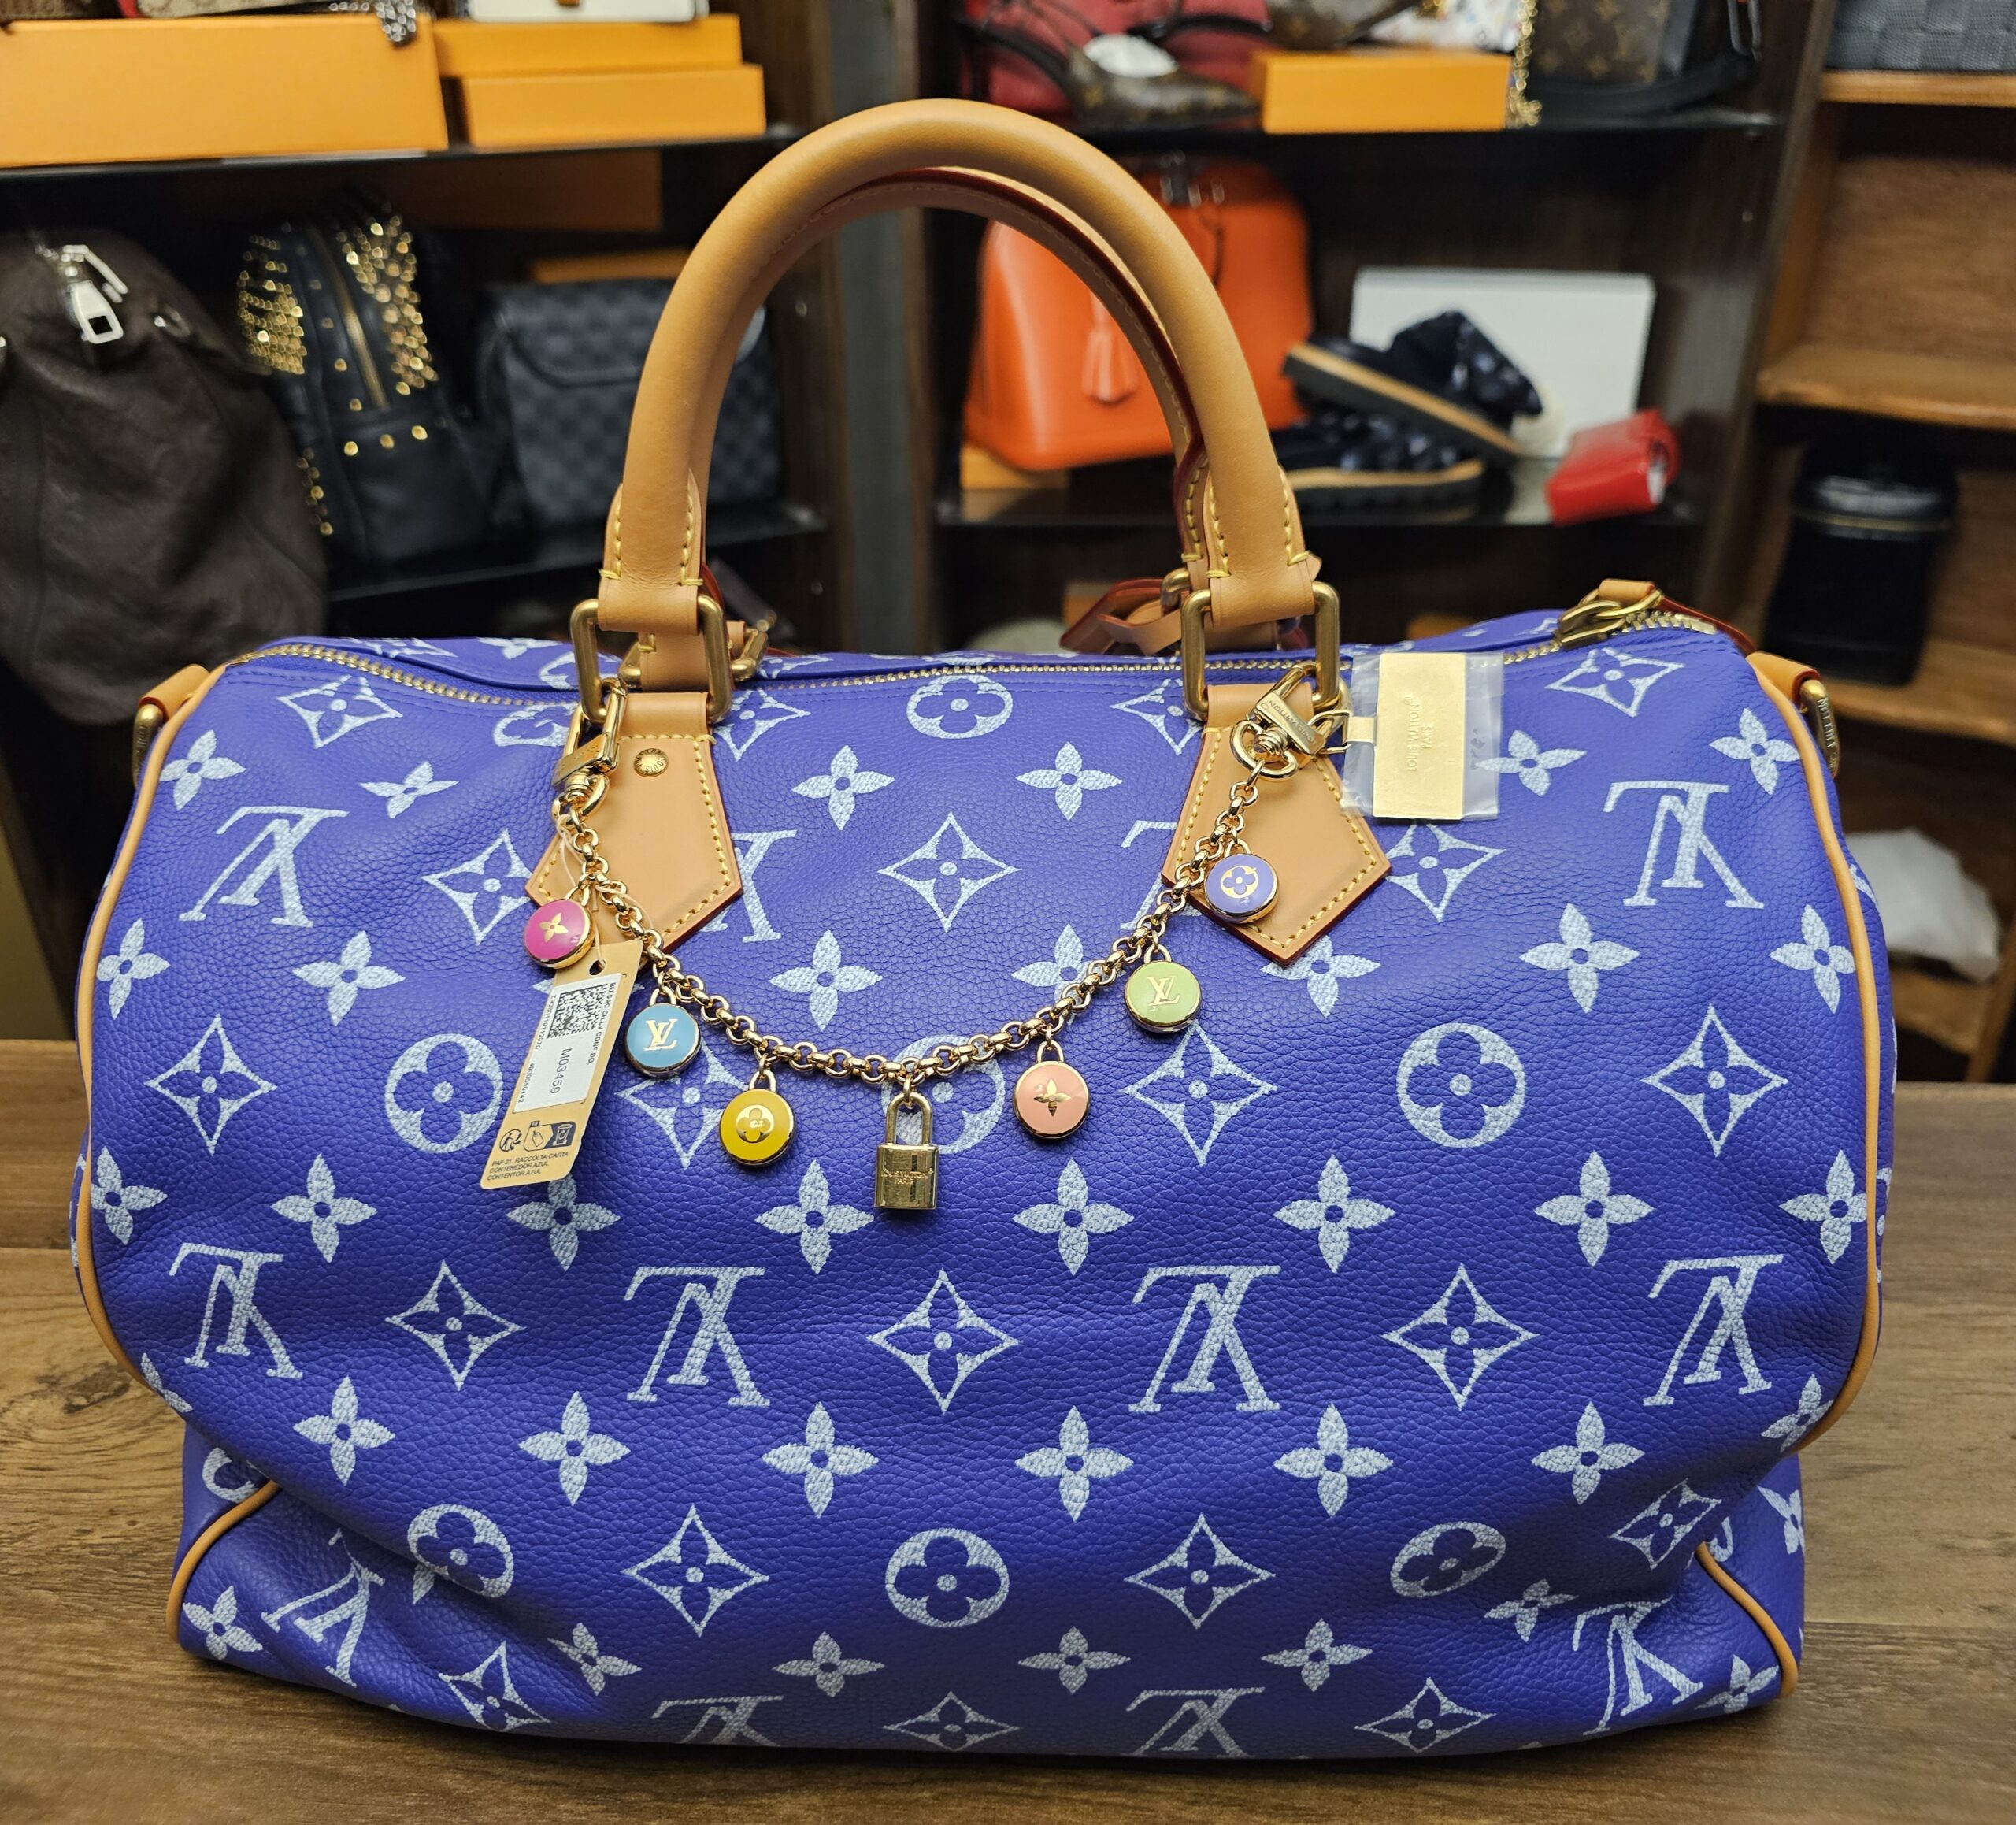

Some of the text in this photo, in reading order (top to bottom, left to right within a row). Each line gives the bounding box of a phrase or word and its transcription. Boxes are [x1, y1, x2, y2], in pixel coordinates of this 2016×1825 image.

[1421, 726, 1432, 749] PARIS
[1406, 746, 1418, 771] LOUIS
[1146, 975, 1180, 1007] LV
[644, 1018, 678, 1050] LV
[549, 1048, 573, 1095] M03459
[489, 1162, 533, 1174] CONTENEDOR
[515, 1153, 547, 1163] RACCOLTA
[548, 1151, 569, 1159] CARTA
[487, 1170, 526, 1181] CONTENTOR
